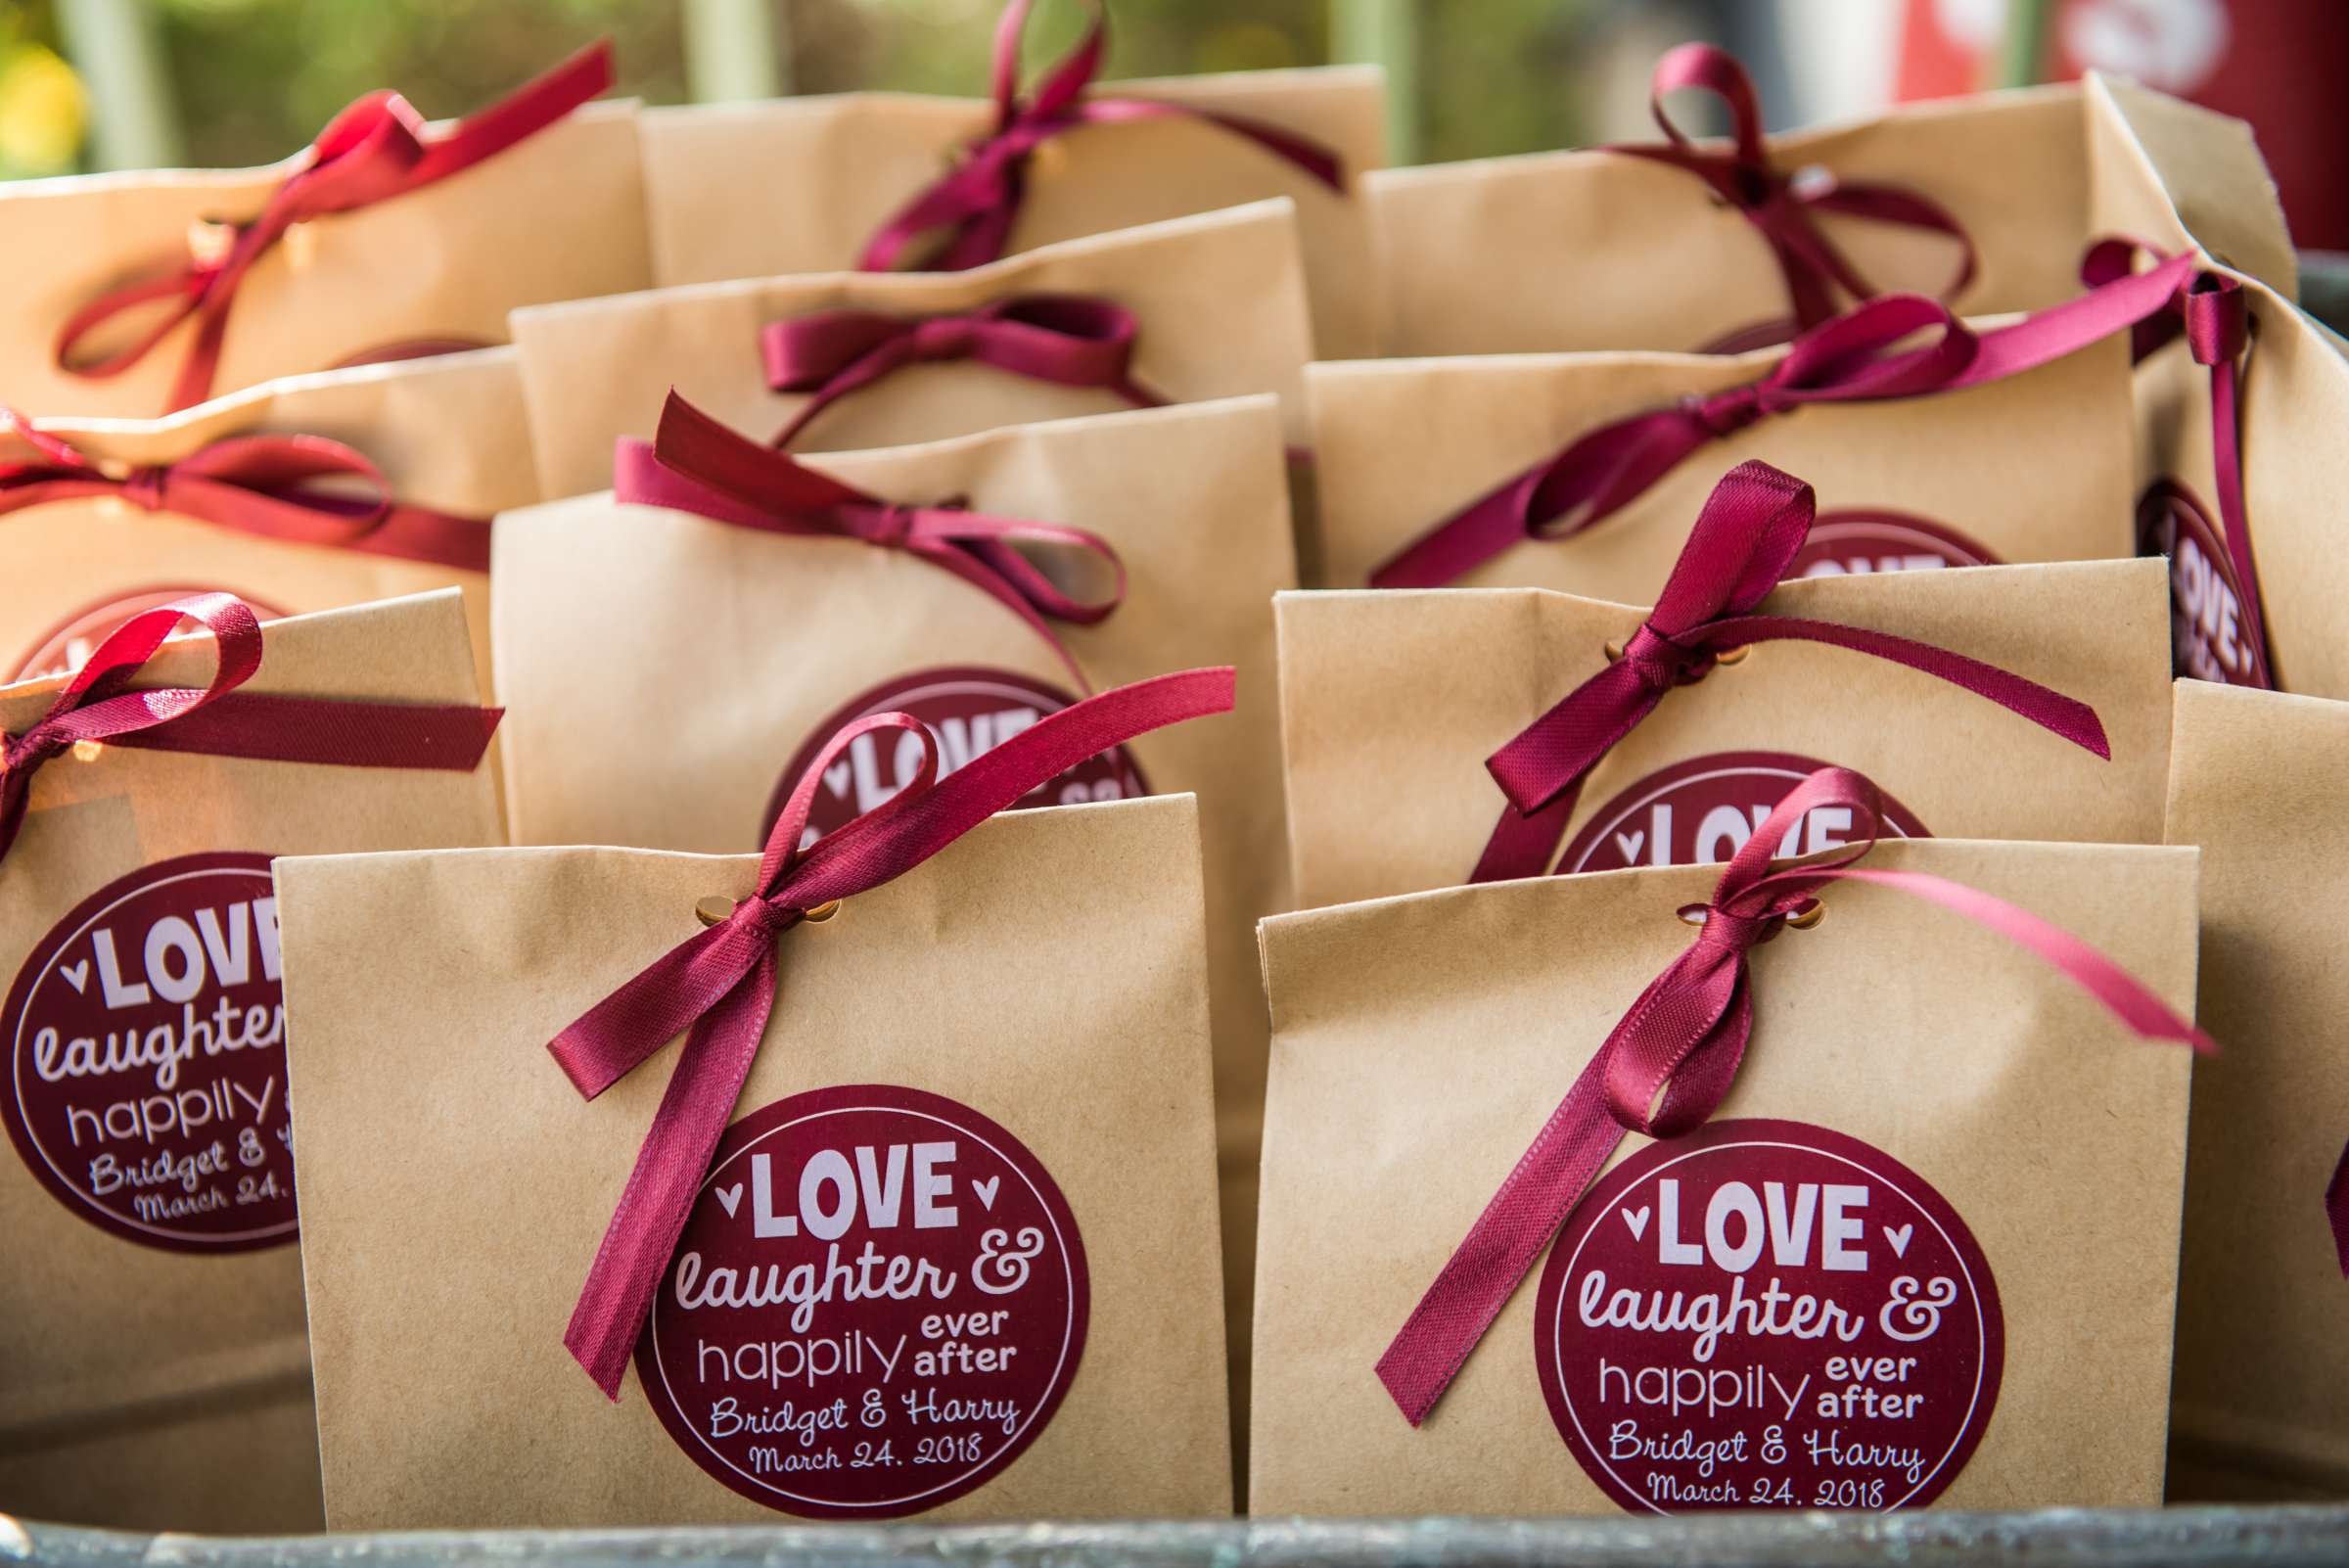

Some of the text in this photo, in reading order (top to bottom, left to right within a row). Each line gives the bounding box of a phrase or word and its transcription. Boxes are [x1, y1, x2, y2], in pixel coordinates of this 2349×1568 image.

[67, 1077, 274, 1147] happily
[88, 1141, 229, 1196] Bridget
[752, 1141, 959, 1240] LOVE
[133, 1185, 229, 1223] March
[1659, 1178, 1869, 1273] LOVE
[675, 1227, 1044, 1333] laughter &
[1579, 1270, 1957, 1361] laughter &
[699, 1311, 1017, 1390] happily ever after
[711, 1388, 1020, 1447] Bridget & Harry
[1600, 1357, 1923, 1421] happily ever after
[749, 1447, 842, 1473] March
[913, 1434, 984, 1465] 2018
[1609, 1419, 1925, 1484] Bridget & Harry
[1647, 1472, 1740, 1502] March
[1814, 1479, 1885, 1507] 2018
